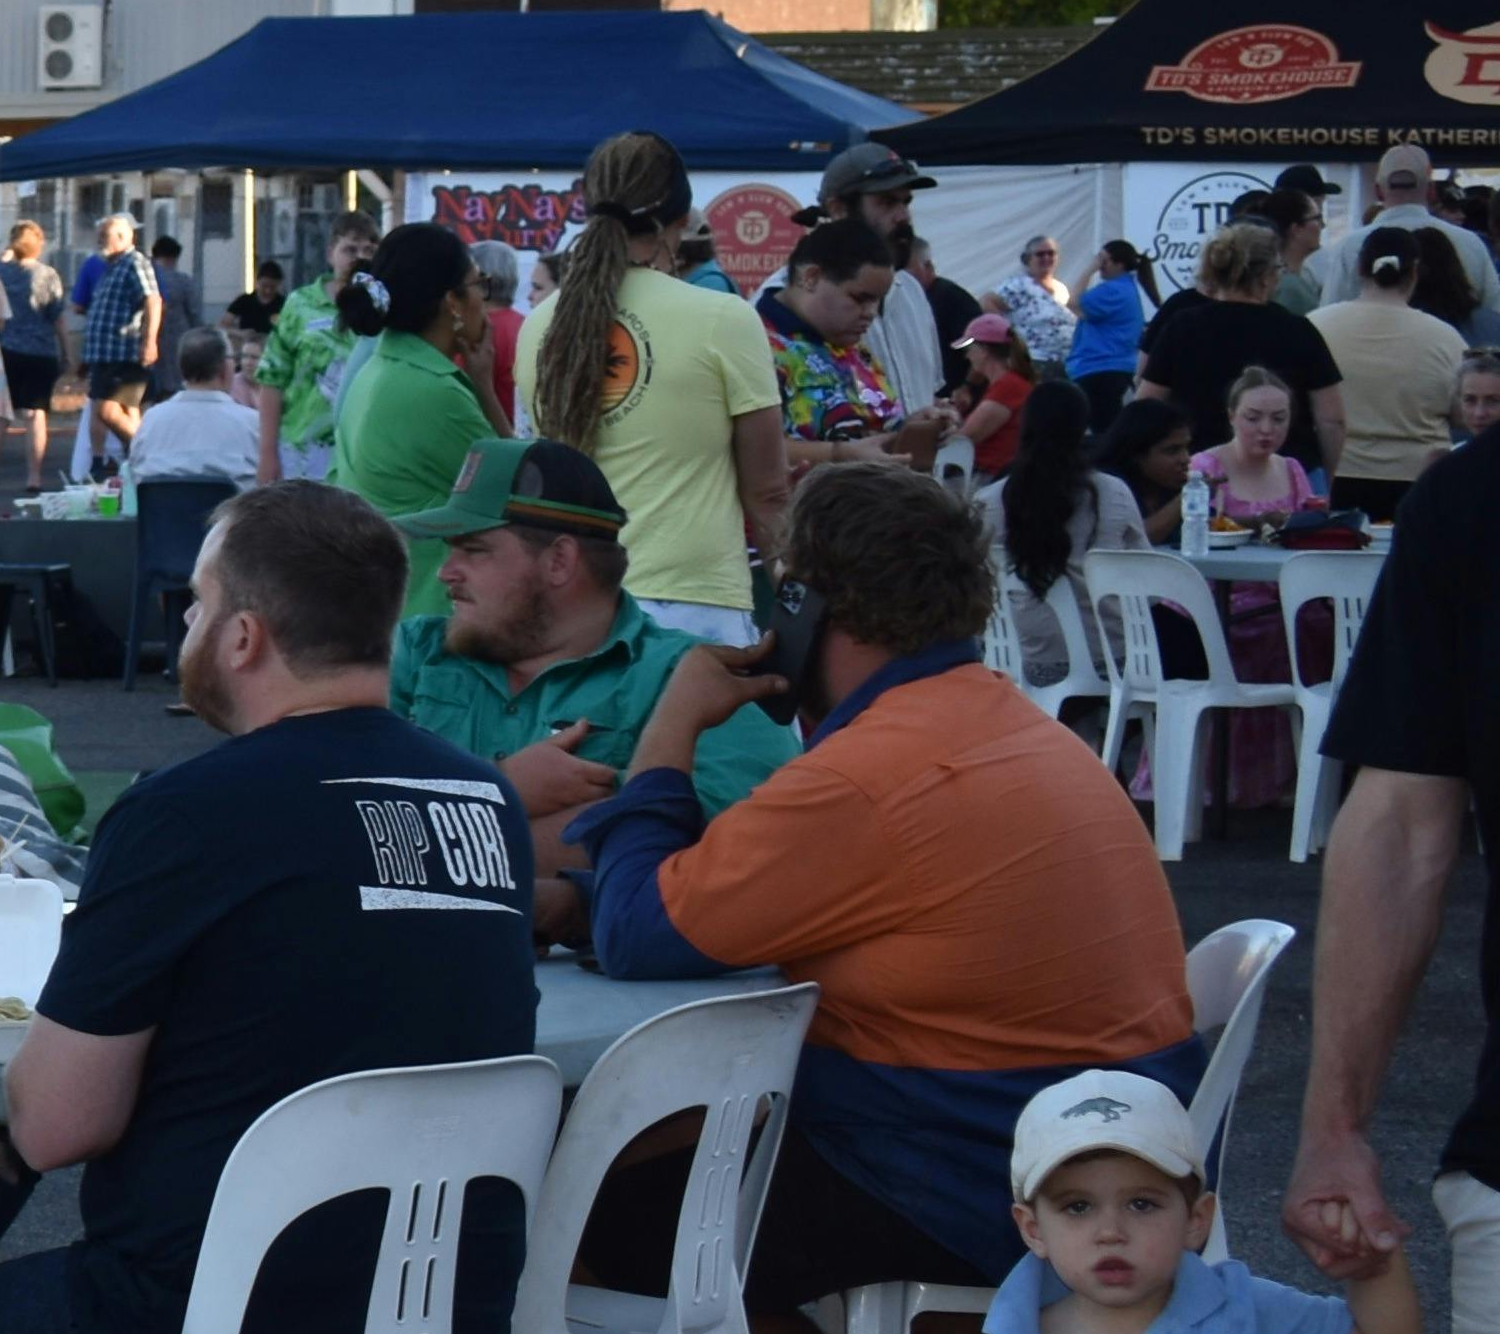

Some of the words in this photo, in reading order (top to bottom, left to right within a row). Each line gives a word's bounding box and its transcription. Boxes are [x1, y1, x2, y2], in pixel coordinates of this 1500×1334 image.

[1160, 71, 1202, 86] TD'S
[1207, 68, 1348, 85] SMOKEHOUSE
[1141, 127, 1196, 144] TD'S
[1204, 127, 1379, 145] SMOKEHOUSE
[1387, 127, 1500, 145] KATHERI
[355, 800, 430, 885] RIP
[426, 801, 517, 890] CURL
